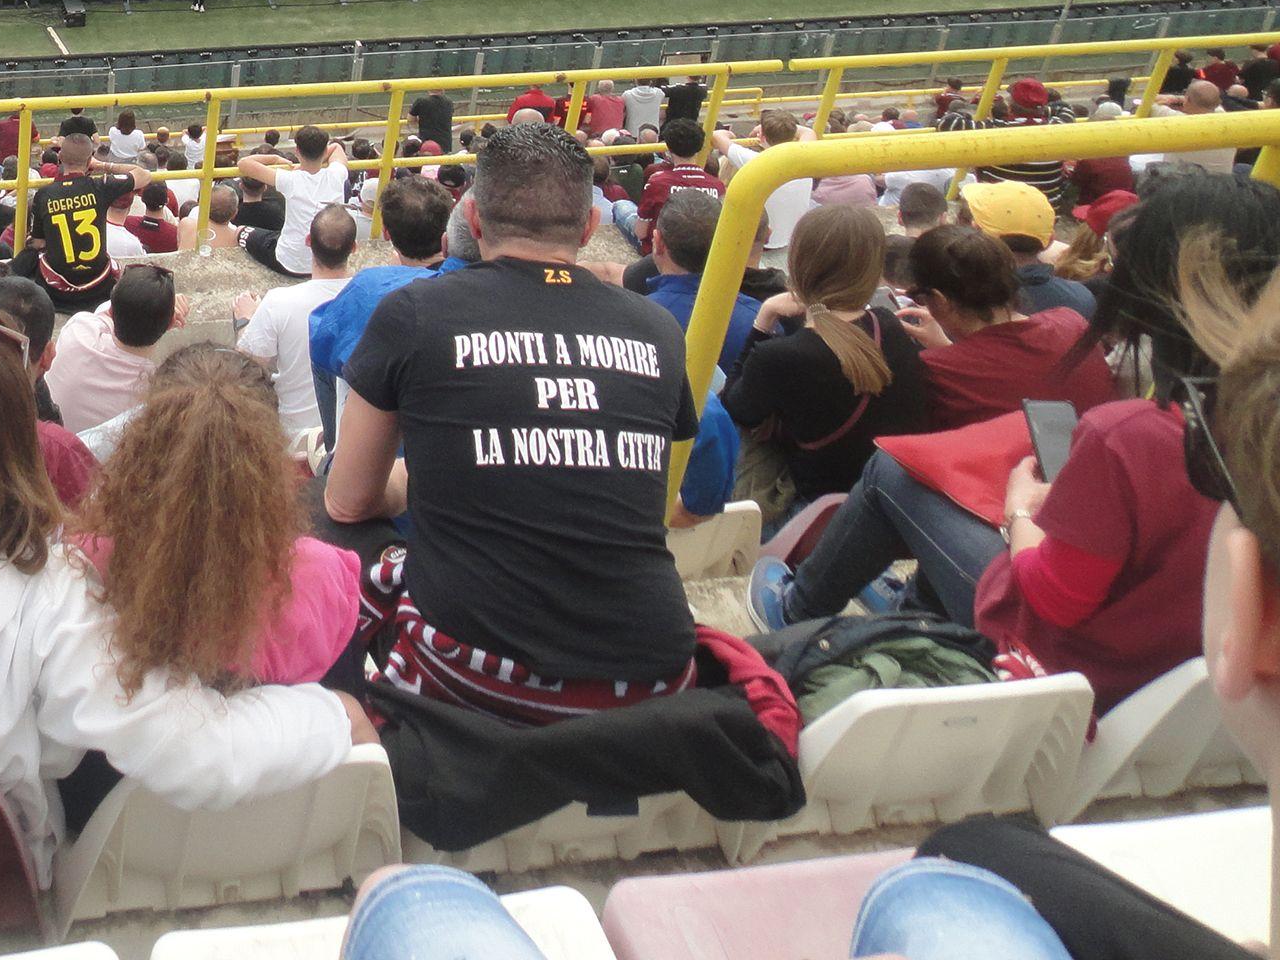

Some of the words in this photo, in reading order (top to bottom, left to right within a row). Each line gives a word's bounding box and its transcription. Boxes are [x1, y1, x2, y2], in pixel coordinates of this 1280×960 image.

[47, 193, 97, 213] ÉDERSON
[51, 208, 101, 263] 13
[544, 269, 572, 283] Z.S
[454, 331, 548, 368] PRONTI
[555, 333, 572, 365] A
[575, 334, 661, 378] MORIRE
[534, 377, 600, 410] PER
[473, 428, 505, 465] LA
[511, 428, 610, 467] NOSTRA
[617, 431, 665, 472] CITTA'
